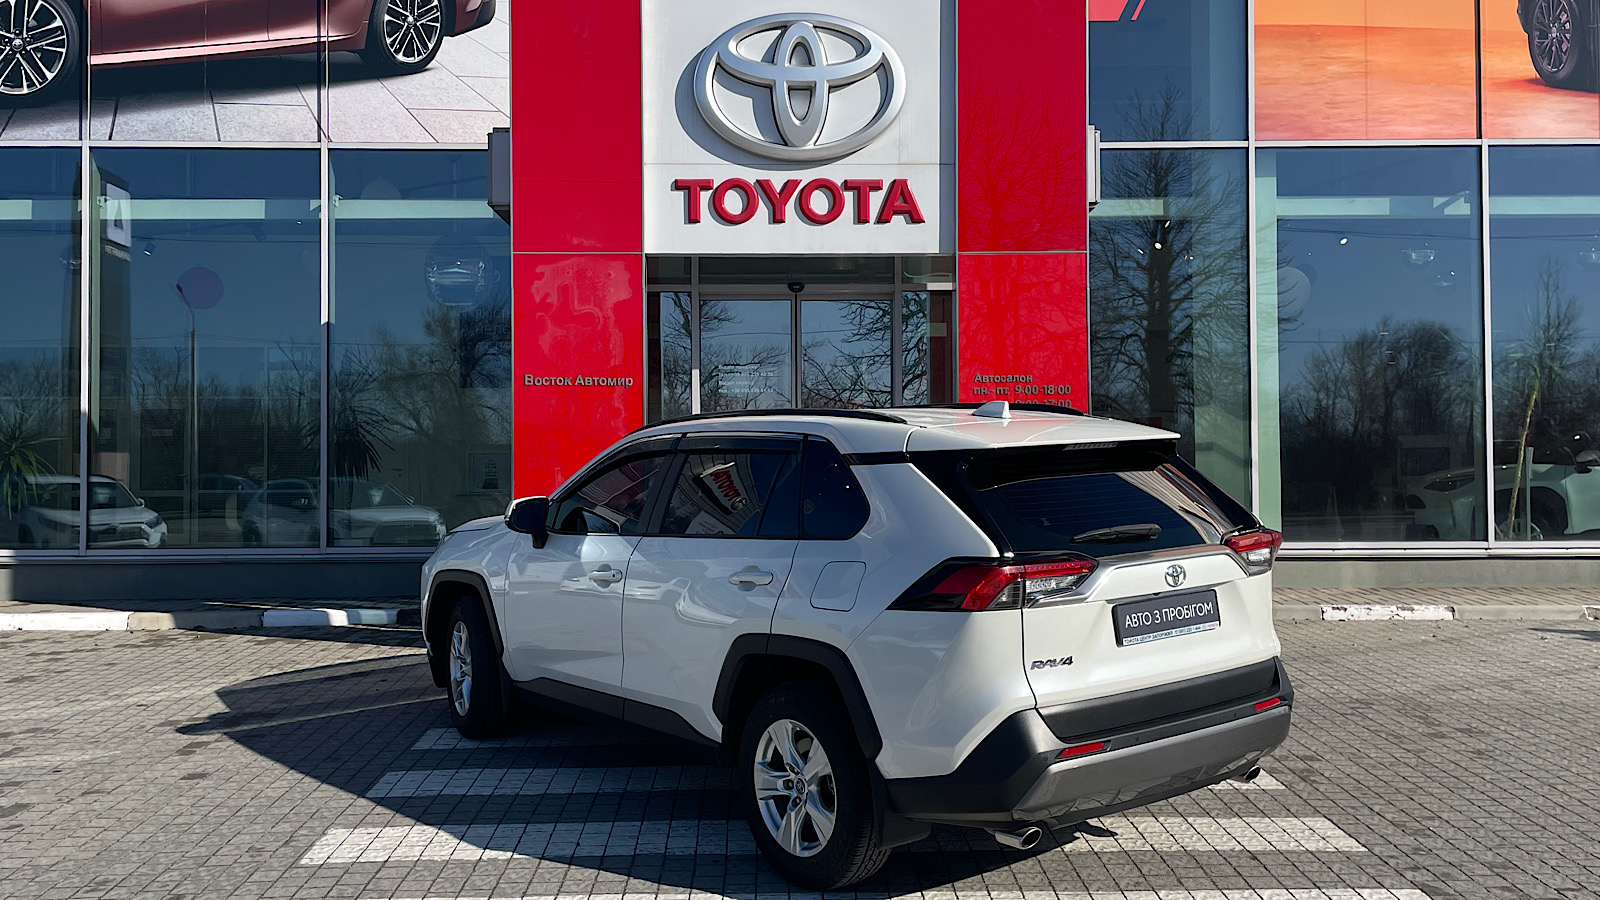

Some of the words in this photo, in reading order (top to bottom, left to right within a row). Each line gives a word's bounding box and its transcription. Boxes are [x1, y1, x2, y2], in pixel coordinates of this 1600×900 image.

[674, 177, 926, 225] TOYOTA
[524, 374, 572, 386] Восток
[574, 374, 634, 389] Автомир
[974, 373, 1033, 383] Автосалон
[1125, 610, 1152, 628] АВТО
[1162, 602, 1214, 623] ПРОБІГОМ
[1030, 655, 1074, 670] RAV4
